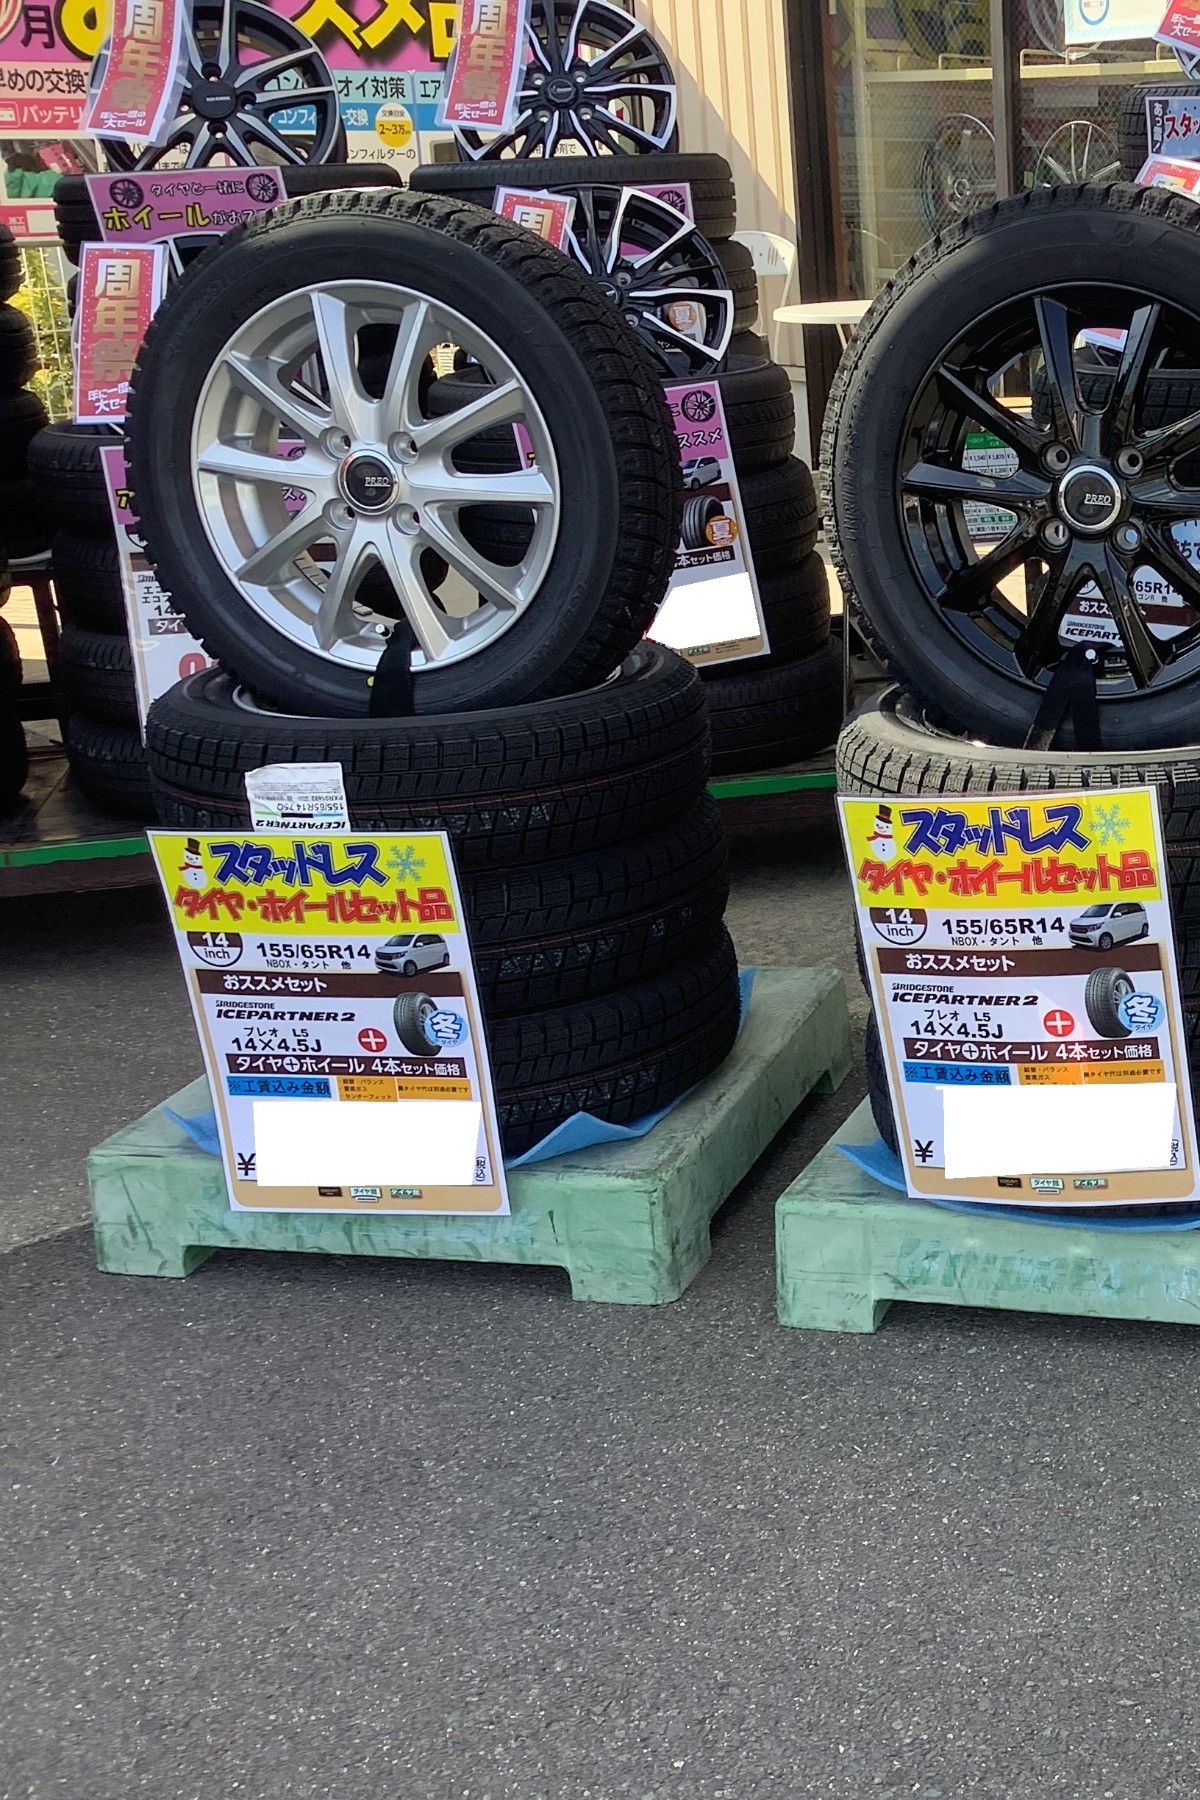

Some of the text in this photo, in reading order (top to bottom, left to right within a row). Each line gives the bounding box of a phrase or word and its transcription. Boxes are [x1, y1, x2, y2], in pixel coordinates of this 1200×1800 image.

[0, 68, 88, 95] めの交換
[1084, 493, 1112, 506] PREO
[900, 804, 1093, 855] スタッドレス
[208, 840, 390, 887] スタッドレス
[885, 908, 913, 924] 14
[886, 923, 914, 938] inch
[942, 916, 1066, 935] 155/65R14
[202, 932, 229, 948] 14
[1032, 935, 1043, 946] 他
[203, 946, 230, 960] inch
[256, 942, 371, 961] 155/65R14
[341, 960, 352, 970] 他
[905, 953, 1016, 971] おススメセット
[222, 974, 328, 992] おススメセット
[891, 983, 955, 993] BRIDGESTONE
[215, 1000, 276, 1010] BRIDGESTONE
[1125, 994, 1159, 1025] 冬
[924, 1009, 992, 1022] プレオ L5
[244, 1026, 309, 1038] プレオ L5
[430, 1011, 462, 1040] 冬
[1055, 1042, 1153, 1061] 4本セット価格
[371, 1058, 460, 1077] 4本セット価格
